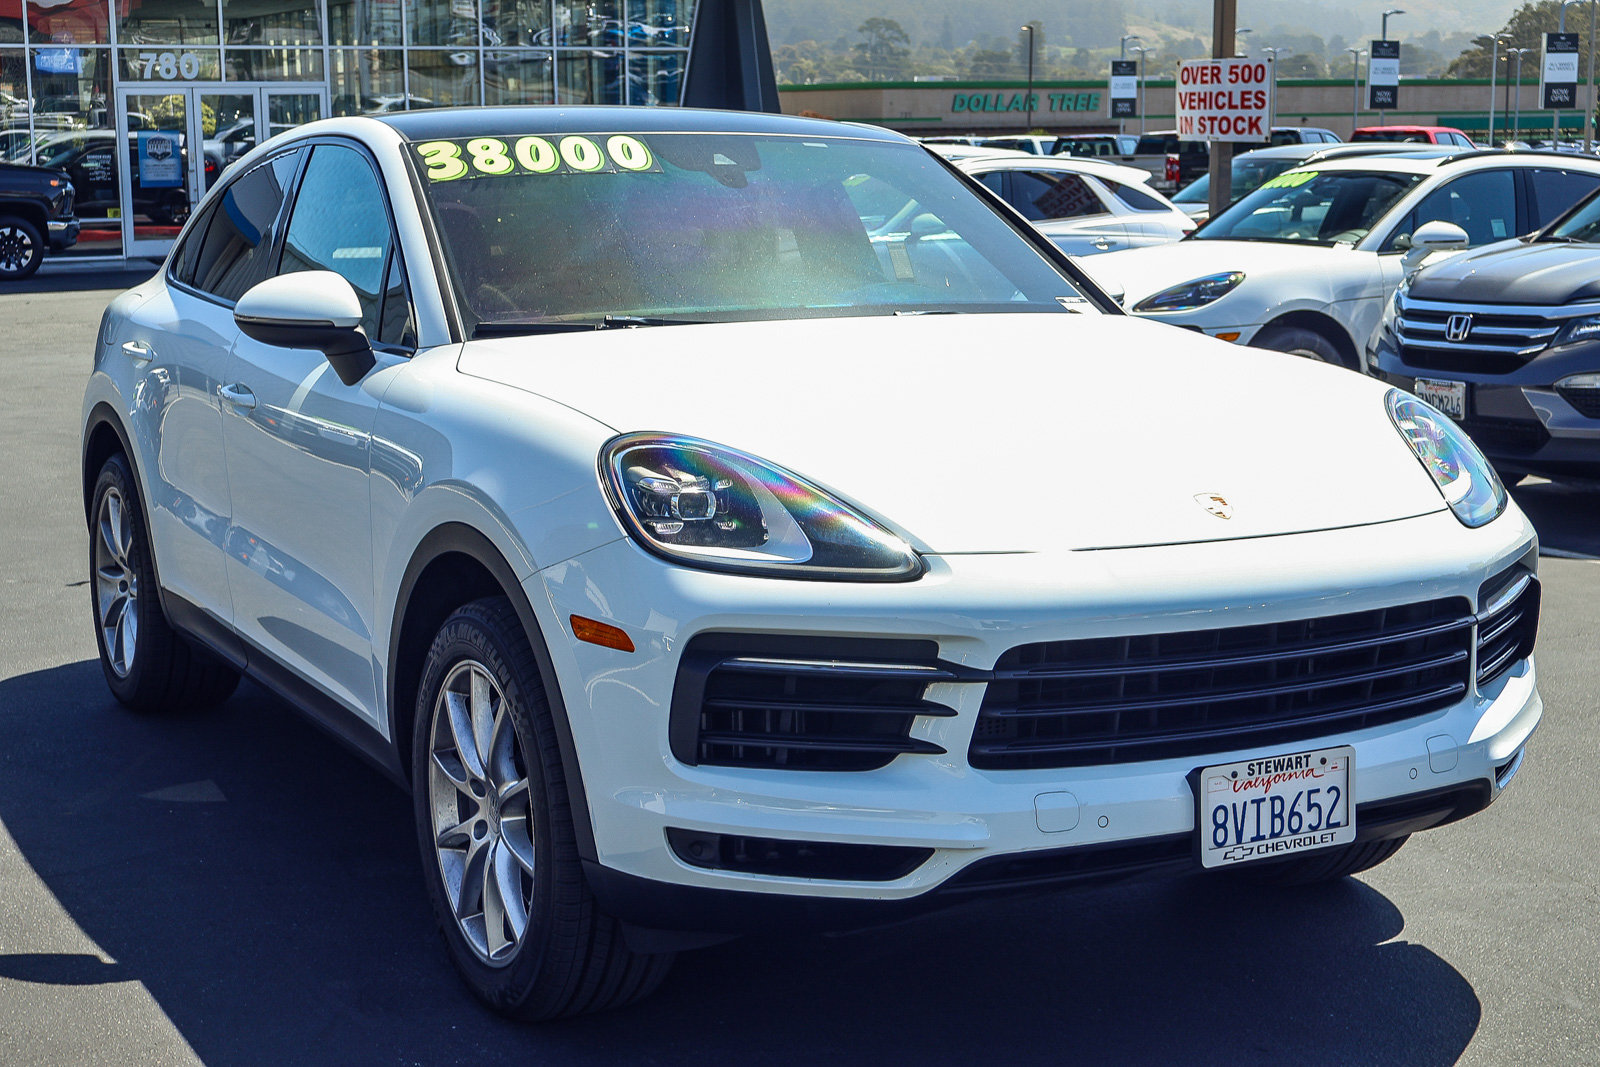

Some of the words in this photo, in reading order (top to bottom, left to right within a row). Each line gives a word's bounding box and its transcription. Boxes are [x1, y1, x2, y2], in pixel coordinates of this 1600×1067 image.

[140, 52, 200, 80] 780
[1180, 64, 1222, 85] OVER
[1227, 62, 1266, 84] 500
[952, 93, 1040, 112] DOLLAR
[1048, 92, 1102, 112] TREE
[1179, 90, 1266, 111] VEHICLES
[1552, 88, 1569, 96] NOW
[1179, 116, 1194, 135] IN
[1197, 115, 1263, 136] STOCK
[417, 135, 653, 181] 38000
[457, 623, 510, 686] MICHELIN
[1248, 754, 1312, 776] STEWART
[1233, 768, 1324, 794] California
[1212, 786, 1341, 848] 8VIB652
[1256, 832, 1337, 855] CHEVROLET
